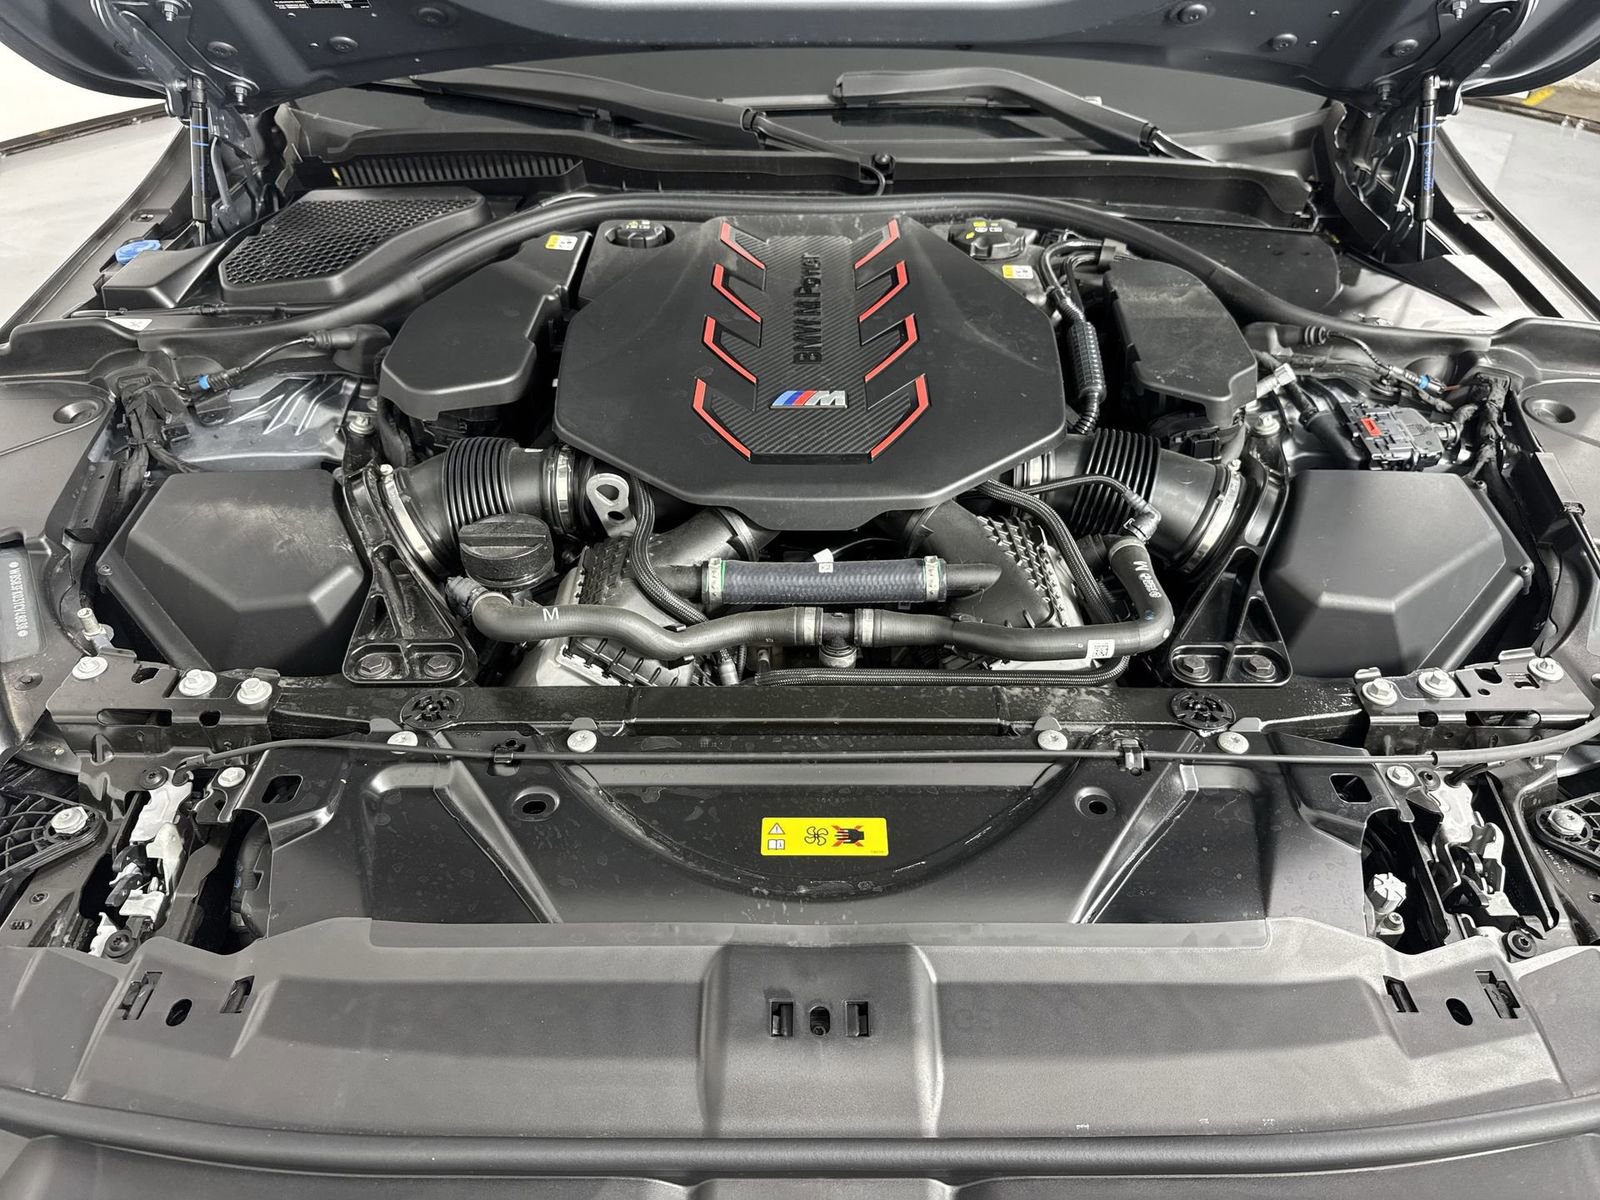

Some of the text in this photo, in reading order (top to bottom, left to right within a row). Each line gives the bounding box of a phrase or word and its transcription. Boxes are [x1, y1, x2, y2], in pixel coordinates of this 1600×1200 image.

[793, 252, 821, 364] BMW M Power
[543, 607, 560, 621] M
